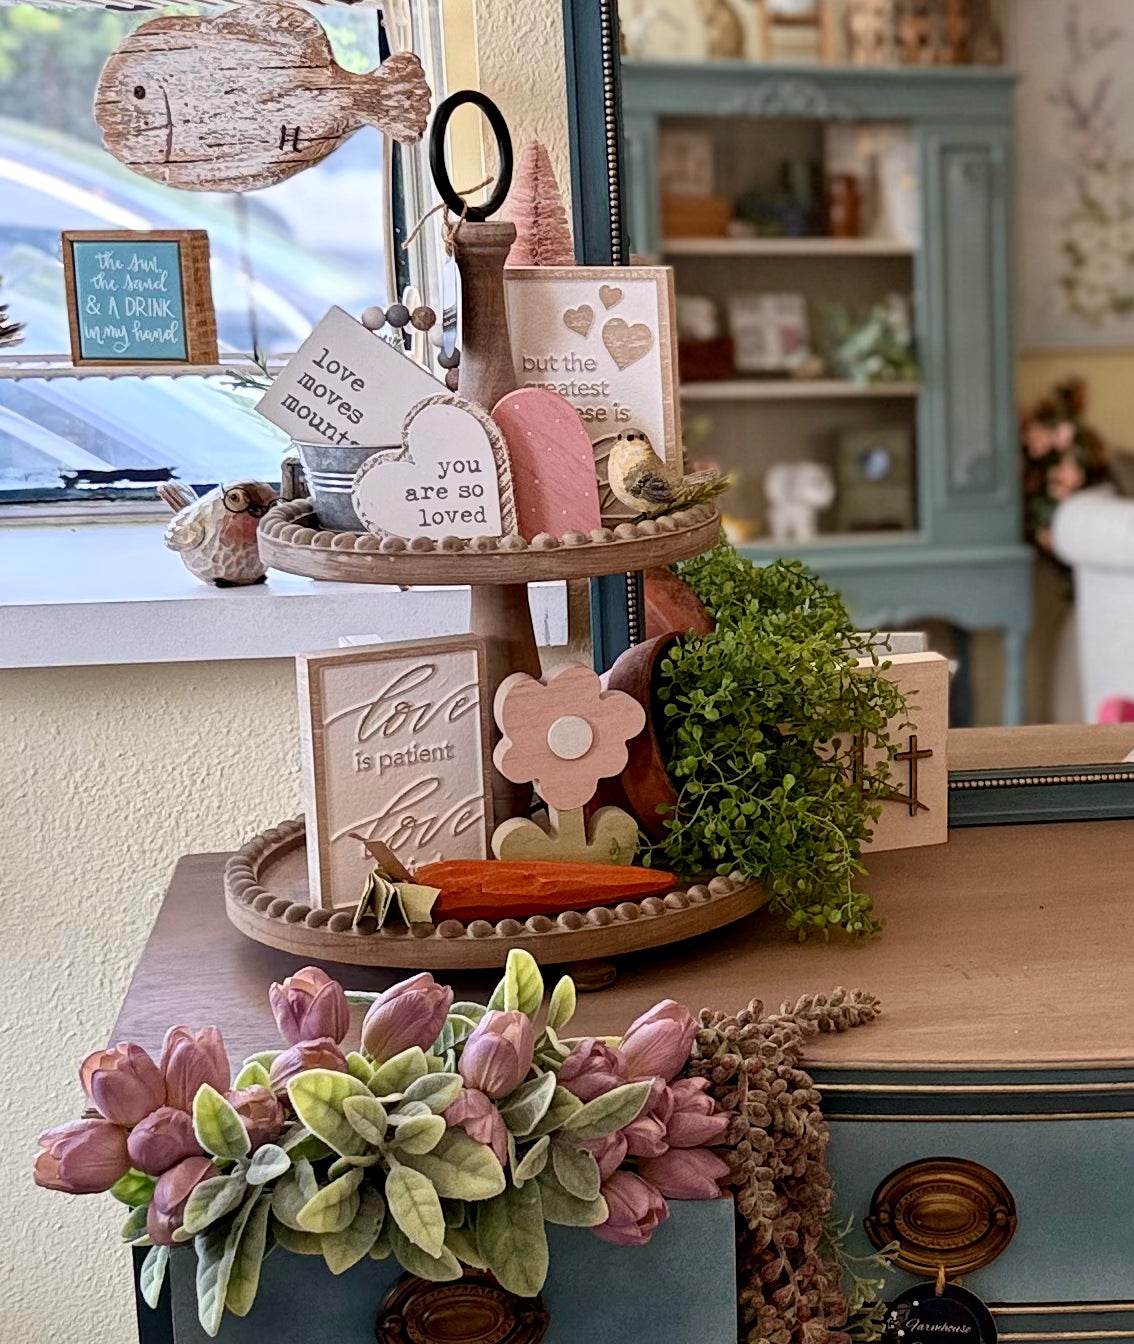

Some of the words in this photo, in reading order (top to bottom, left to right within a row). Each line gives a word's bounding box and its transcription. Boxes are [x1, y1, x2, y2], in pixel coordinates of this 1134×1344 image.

[95, 251, 124, 270] the
[90, 271, 119, 291] the
[123, 270, 168, 291] sand
[86, 295, 101, 315] &
[125, 297, 176, 318] DRINK
[104, 325, 130, 353] my
[312, 347, 365, 392] love
[522, 355, 560, 373] but
[561, 352, 598, 373] the
[296, 372, 364, 425] moves
[280, 393, 360, 445] mount
[613, 402, 632, 423] is
[437, 459, 483, 479] you
[405, 486, 449, 502] are
[458, 484, 484, 498] so
[418, 505, 488, 527] loved
[324, 663, 480, 743] love
[355, 751, 372, 772] is
[379, 742, 456, 775] patient
[330, 776, 485, 857] love
